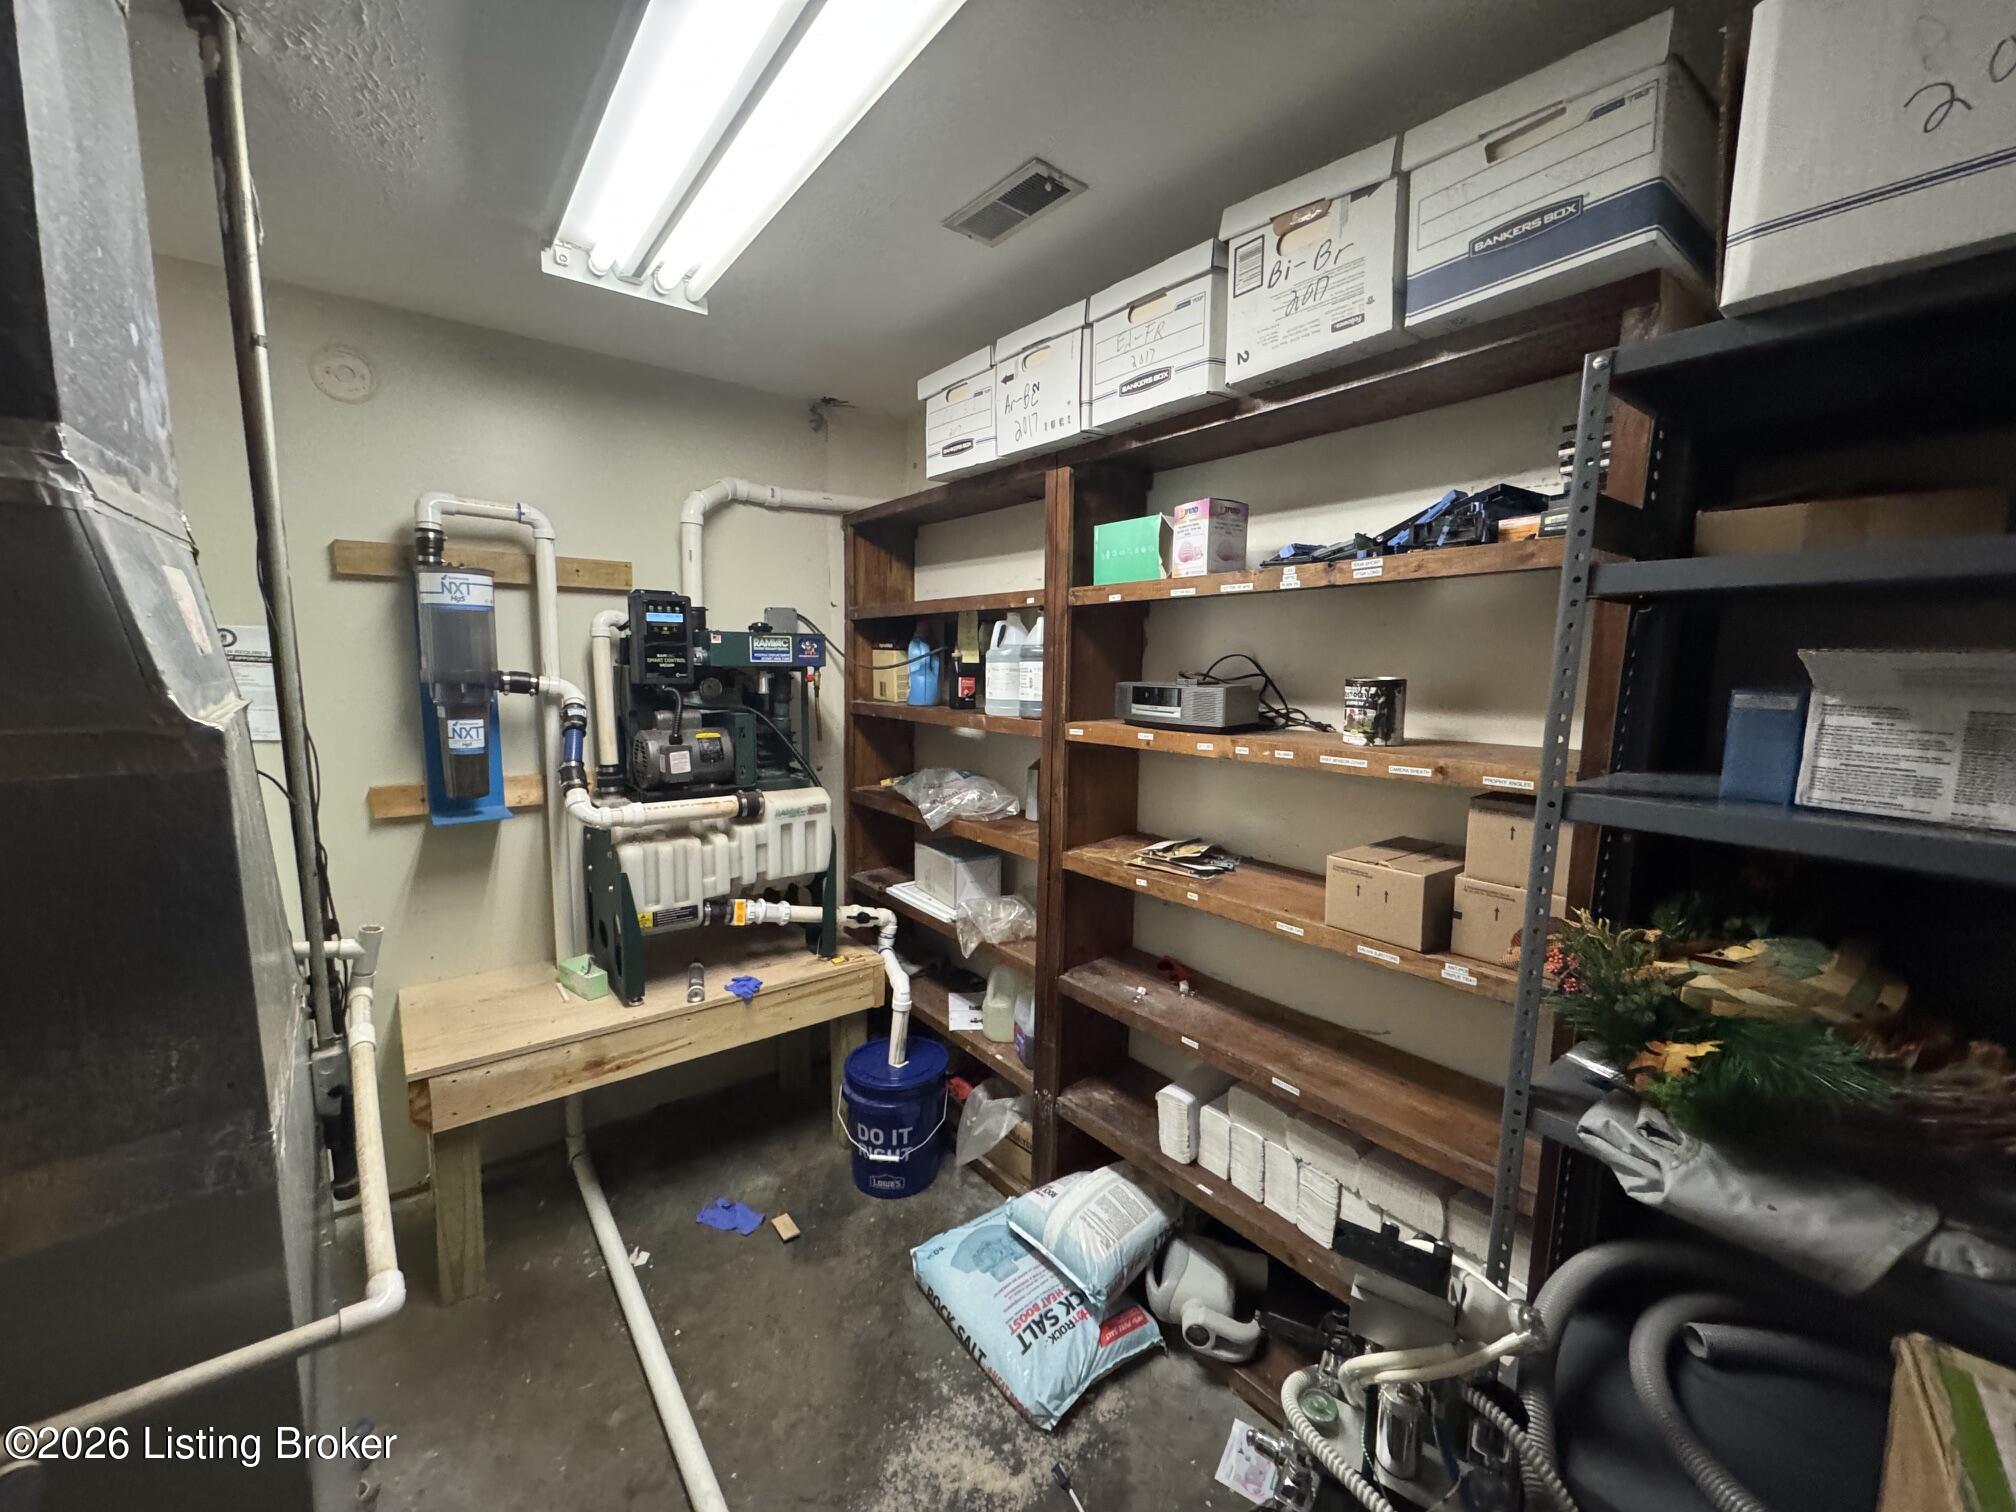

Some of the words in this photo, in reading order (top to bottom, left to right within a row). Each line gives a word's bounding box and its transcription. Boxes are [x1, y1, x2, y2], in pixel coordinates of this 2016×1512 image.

[1474, 218, 1542, 252] BANKERS
[1543, 203, 1577, 224] BOX
[441, 581, 470, 596] NXT
[453, 726, 480, 739] NXT
[857, 1123, 884, 1146] DO
[891, 1126, 913, 1146] IT
[1058, 1290, 1085, 1317] CK
[1008, 1304, 1042, 1336] BOOST
[1015, 1308, 1060, 1356] SALT
